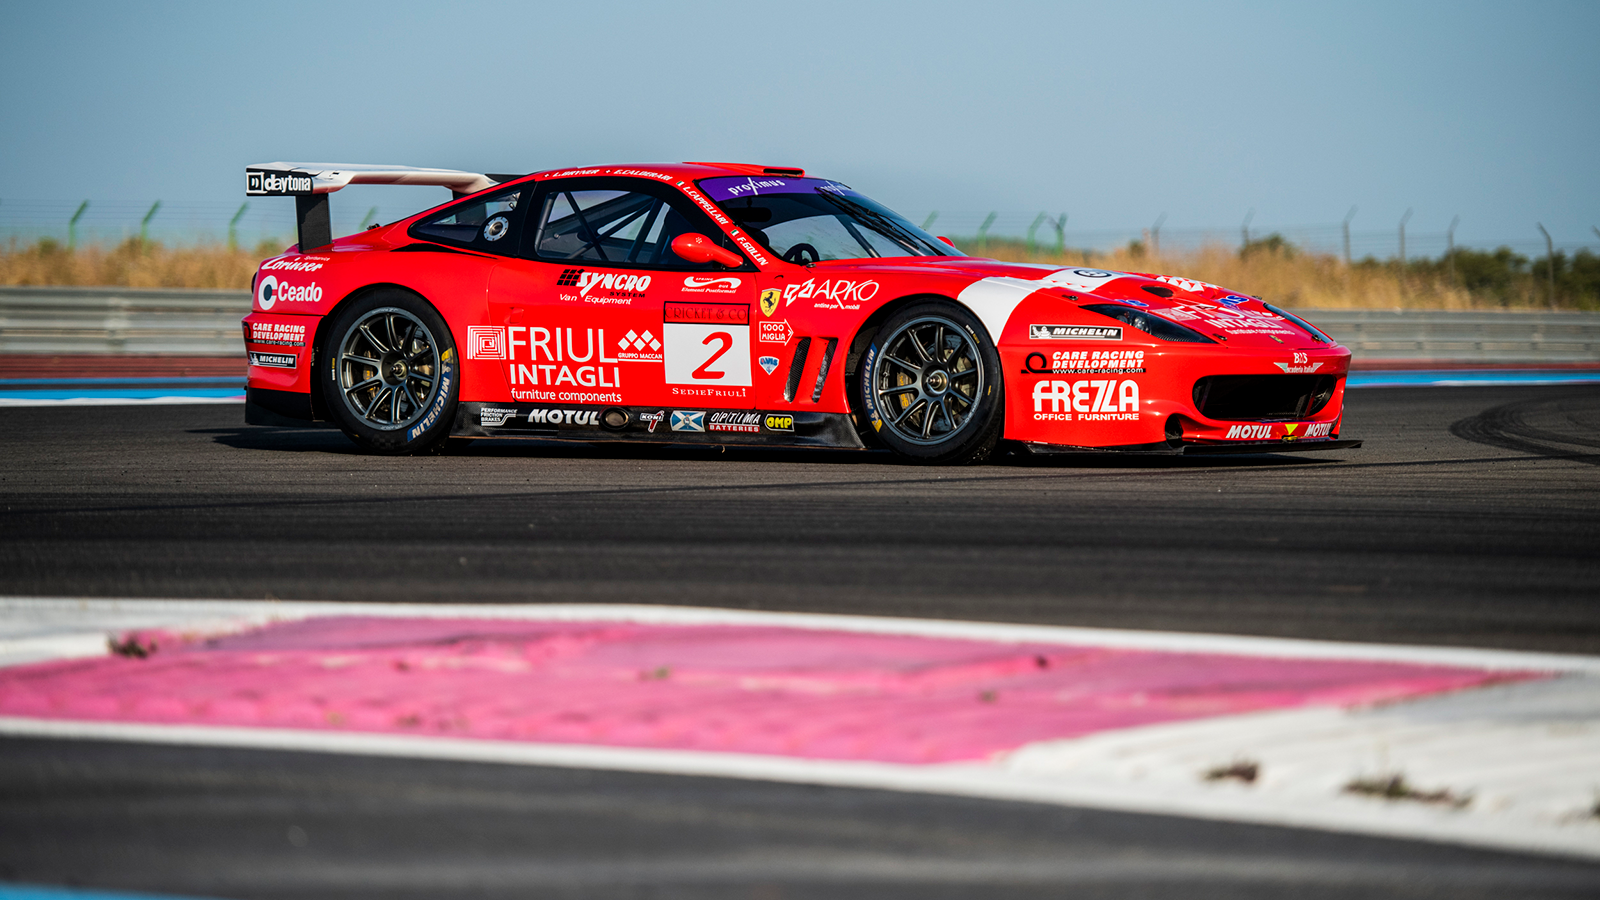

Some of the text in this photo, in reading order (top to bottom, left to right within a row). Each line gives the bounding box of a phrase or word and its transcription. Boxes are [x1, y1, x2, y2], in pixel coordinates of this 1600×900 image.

[264, 174, 312, 194] daytona
[728, 177, 786, 196] proximus
[682, 186, 729, 226] L.CAPPELLARI
[736, 236, 769, 267] F.GOLLIN
[277, 281, 323, 303] Ceado
[576, 272, 652, 298] SYNCRO
[560, 293, 632, 305] Van Equipment
[812, 279, 880, 310] ARKO
[665, 306, 713, 320] CRICKET
[253, 322, 306, 334] CARE RACING
[762, 323, 785, 332] 1000
[1052, 327, 1119, 337] MICHELIN
[253, 331, 306, 342] DEVELOPMENT
[761, 333, 786, 341] MIGLIA
[508, 326, 619, 364] FRIUL
[259, 354, 295, 365] MICHELIN
[640, 352, 663, 360] MACCAN
[691, 330, 734, 380] 2
[1052, 350, 1145, 361] CARE RACING
[1052, 359, 1145, 369] DEVELOPMENT
[1052, 367, 1144, 375] www.care-racing.com
[509, 364, 621, 388] INTAGLI
[863, 349, 875, 410] MICHELIN
[511, 388, 623, 404] furniture components
[1032, 379, 1140, 413] FREZZA
[411, 376, 451, 438] MICHELIN
[527, 408, 600, 426] MOTUL
[709, 411, 761, 425] OPTIMA
[766, 416, 793, 429] OMP
[1033, 413, 1140, 421] OFFICE FURNITURE
[709, 424, 760, 433] BATTERIES
[1225, 425, 1273, 439] MOTUL
[1304, 423, 1332, 436] MOTUL
